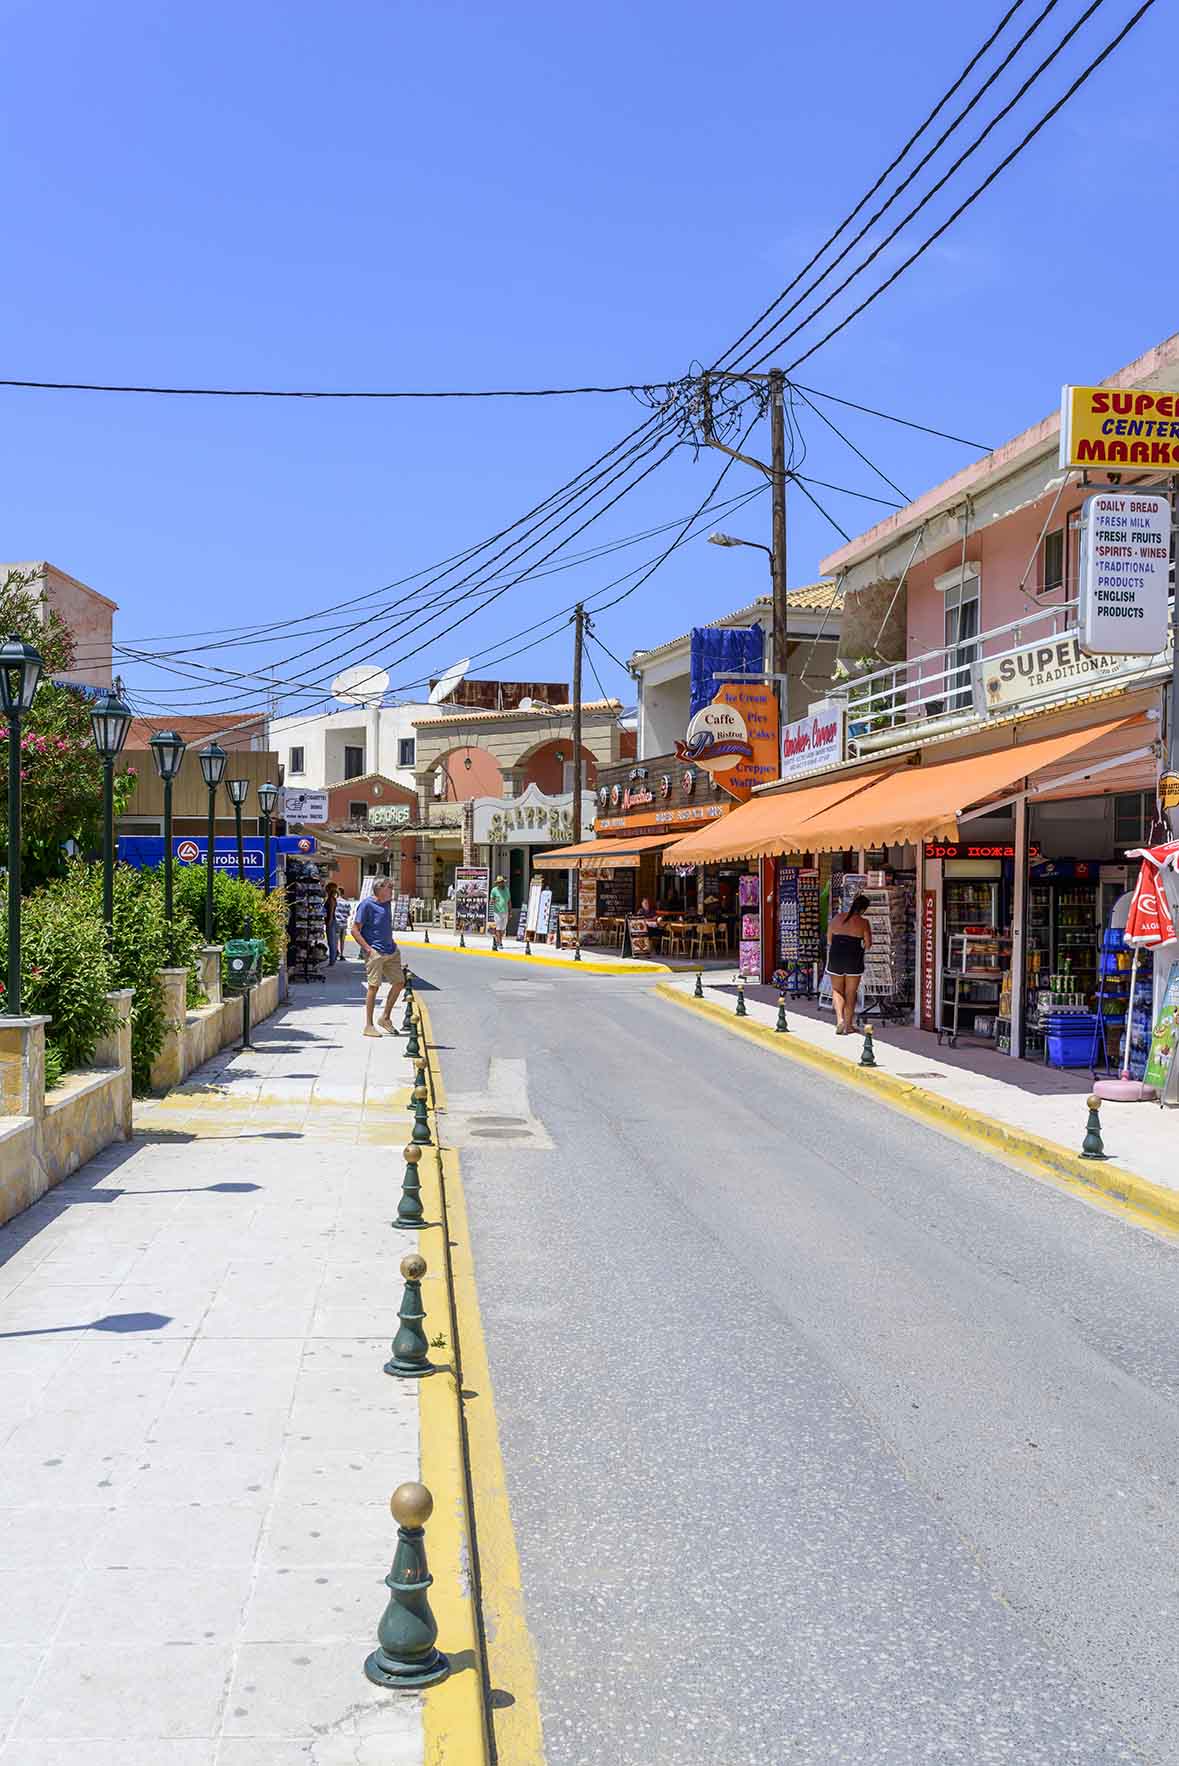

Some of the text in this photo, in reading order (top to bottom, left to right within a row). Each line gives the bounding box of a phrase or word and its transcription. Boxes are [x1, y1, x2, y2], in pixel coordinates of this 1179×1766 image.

[1102, 419, 1179, 438] CENTER
[1100, 501, 1158, 512] DAILY BREAD
[1100, 517, 1151, 528] FRESH MILK
[1099, 532, 1162, 543] FRESH FRUITS
[1099, 547, 1132, 557] SPIRITS
[1140, 548, 1167, 558] WINES
[1099, 561, 1155, 573] TRADITIONAL
[1098, 577, 1144, 588] PRODUCTS
[1098, 591, 1135, 601] ENGLISH
[1097, 606, 1144, 618] PRODUCTS
[1028, 655, 1117, 687] TRADITIONAL
[739, 692, 767, 703] Cream
[705, 713, 735, 725] Caffe
[747, 712, 768, 722] Pies
[201, 853, 257, 865] Erobank
[925, 898, 933, 964] DONUTS
